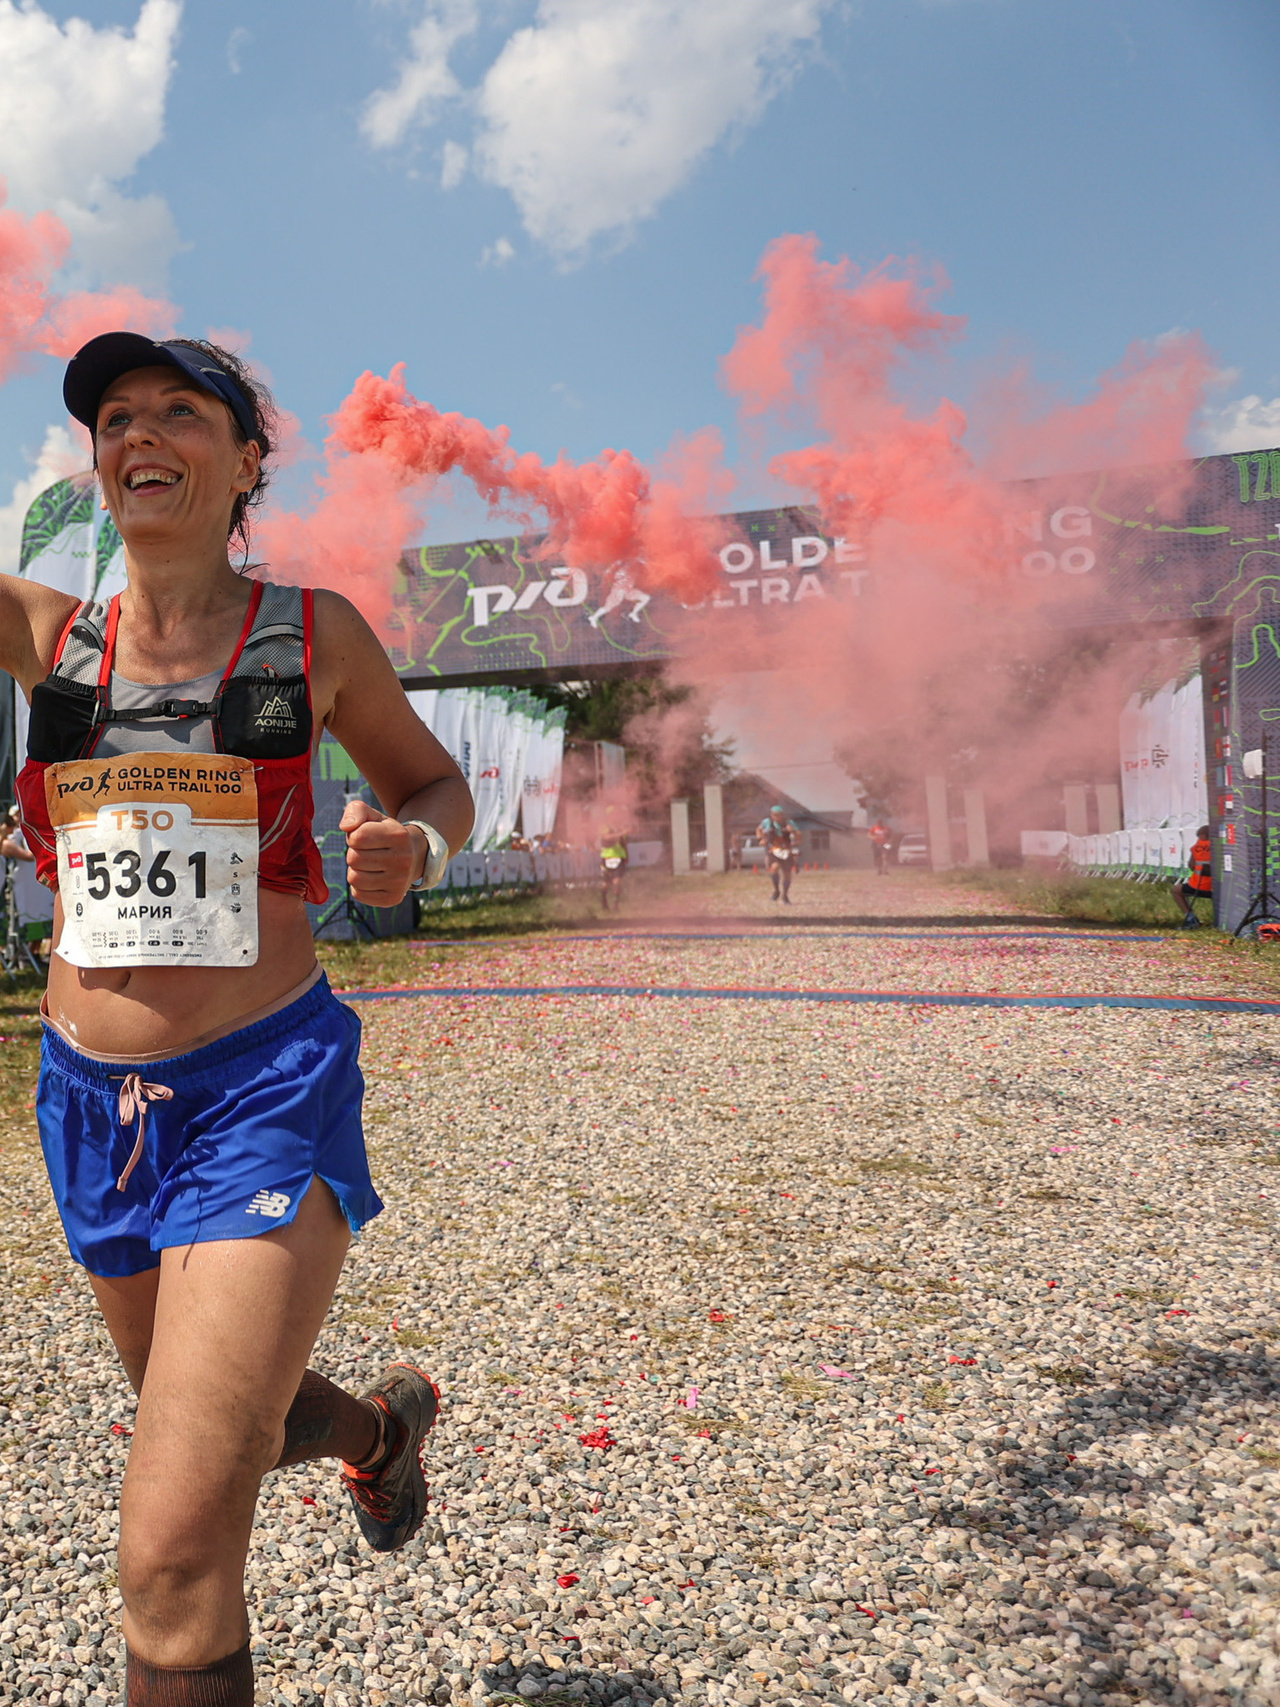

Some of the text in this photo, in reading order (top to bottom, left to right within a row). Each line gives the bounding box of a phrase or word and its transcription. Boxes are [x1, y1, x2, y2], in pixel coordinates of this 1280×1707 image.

[718, 537, 867, 575] OLDE
[254, 718, 297, 729] AONIJIE
[117, 767, 242, 782] GOLDEN RING
[117, 780, 242, 795] ULTRA TRAIL 100
[110, 809, 175, 832] T50
[85, 850, 207, 901] 5361
[117, 905, 173, 920] МАРИЯ
